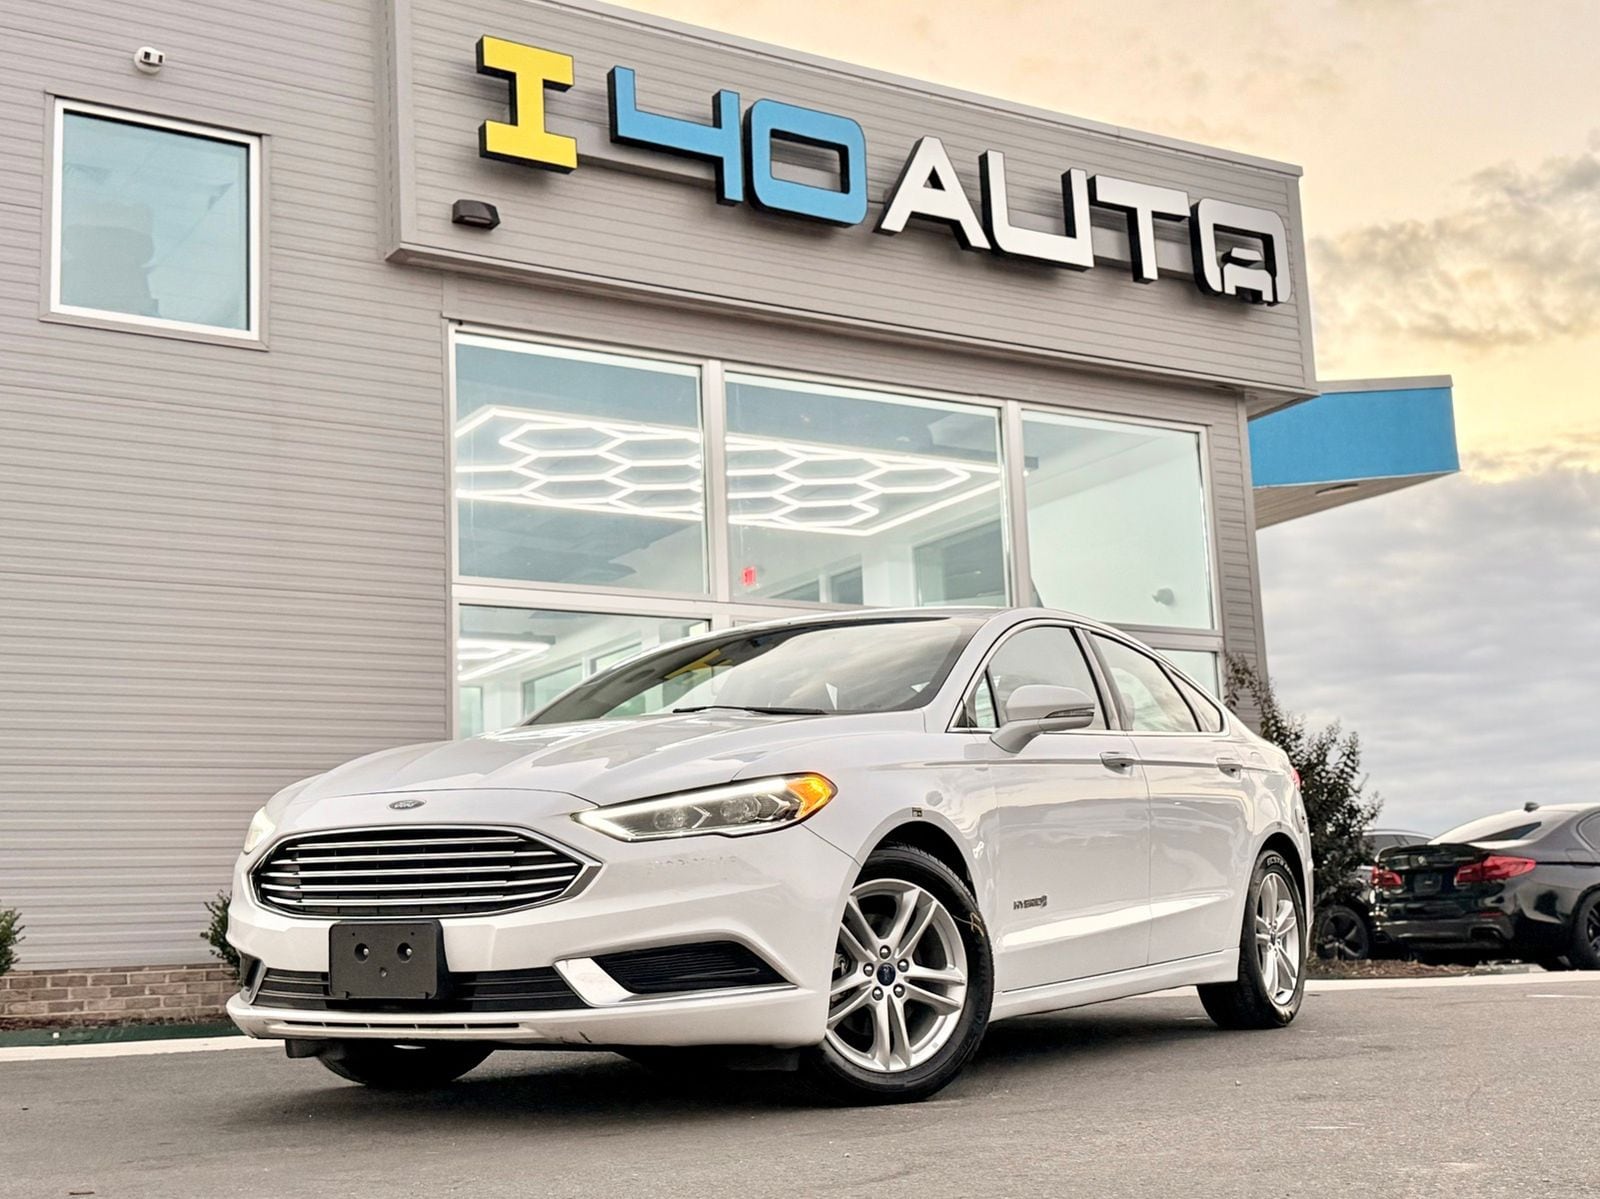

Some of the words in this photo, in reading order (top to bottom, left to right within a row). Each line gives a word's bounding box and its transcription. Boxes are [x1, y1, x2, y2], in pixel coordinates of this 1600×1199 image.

[477, 35, 578, 173] I
[607, 65, 867, 228] 40
[875, 135, 1293, 306] AUTO
